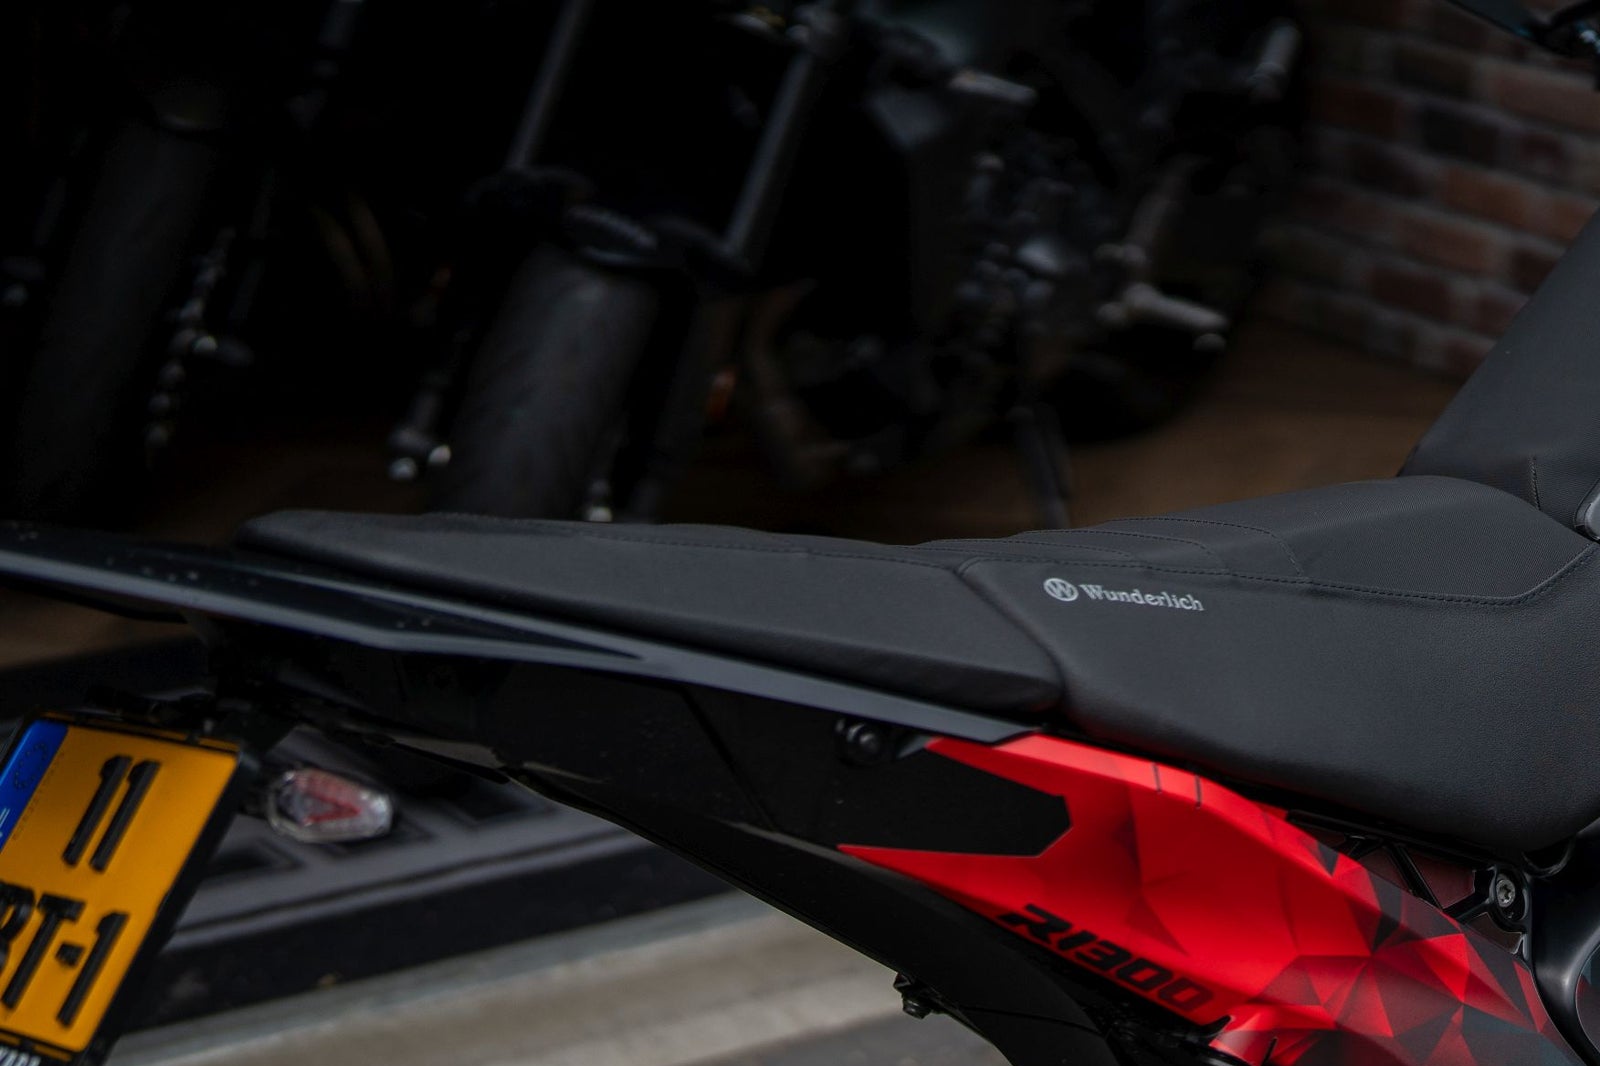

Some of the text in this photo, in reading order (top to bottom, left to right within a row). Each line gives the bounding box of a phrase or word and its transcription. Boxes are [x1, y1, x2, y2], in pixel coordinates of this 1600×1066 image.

[1077, 583, 1206, 612] Wunderlich
[62, 754, 161, 873] 11
[998, 903, 1215, 1012] R1300
